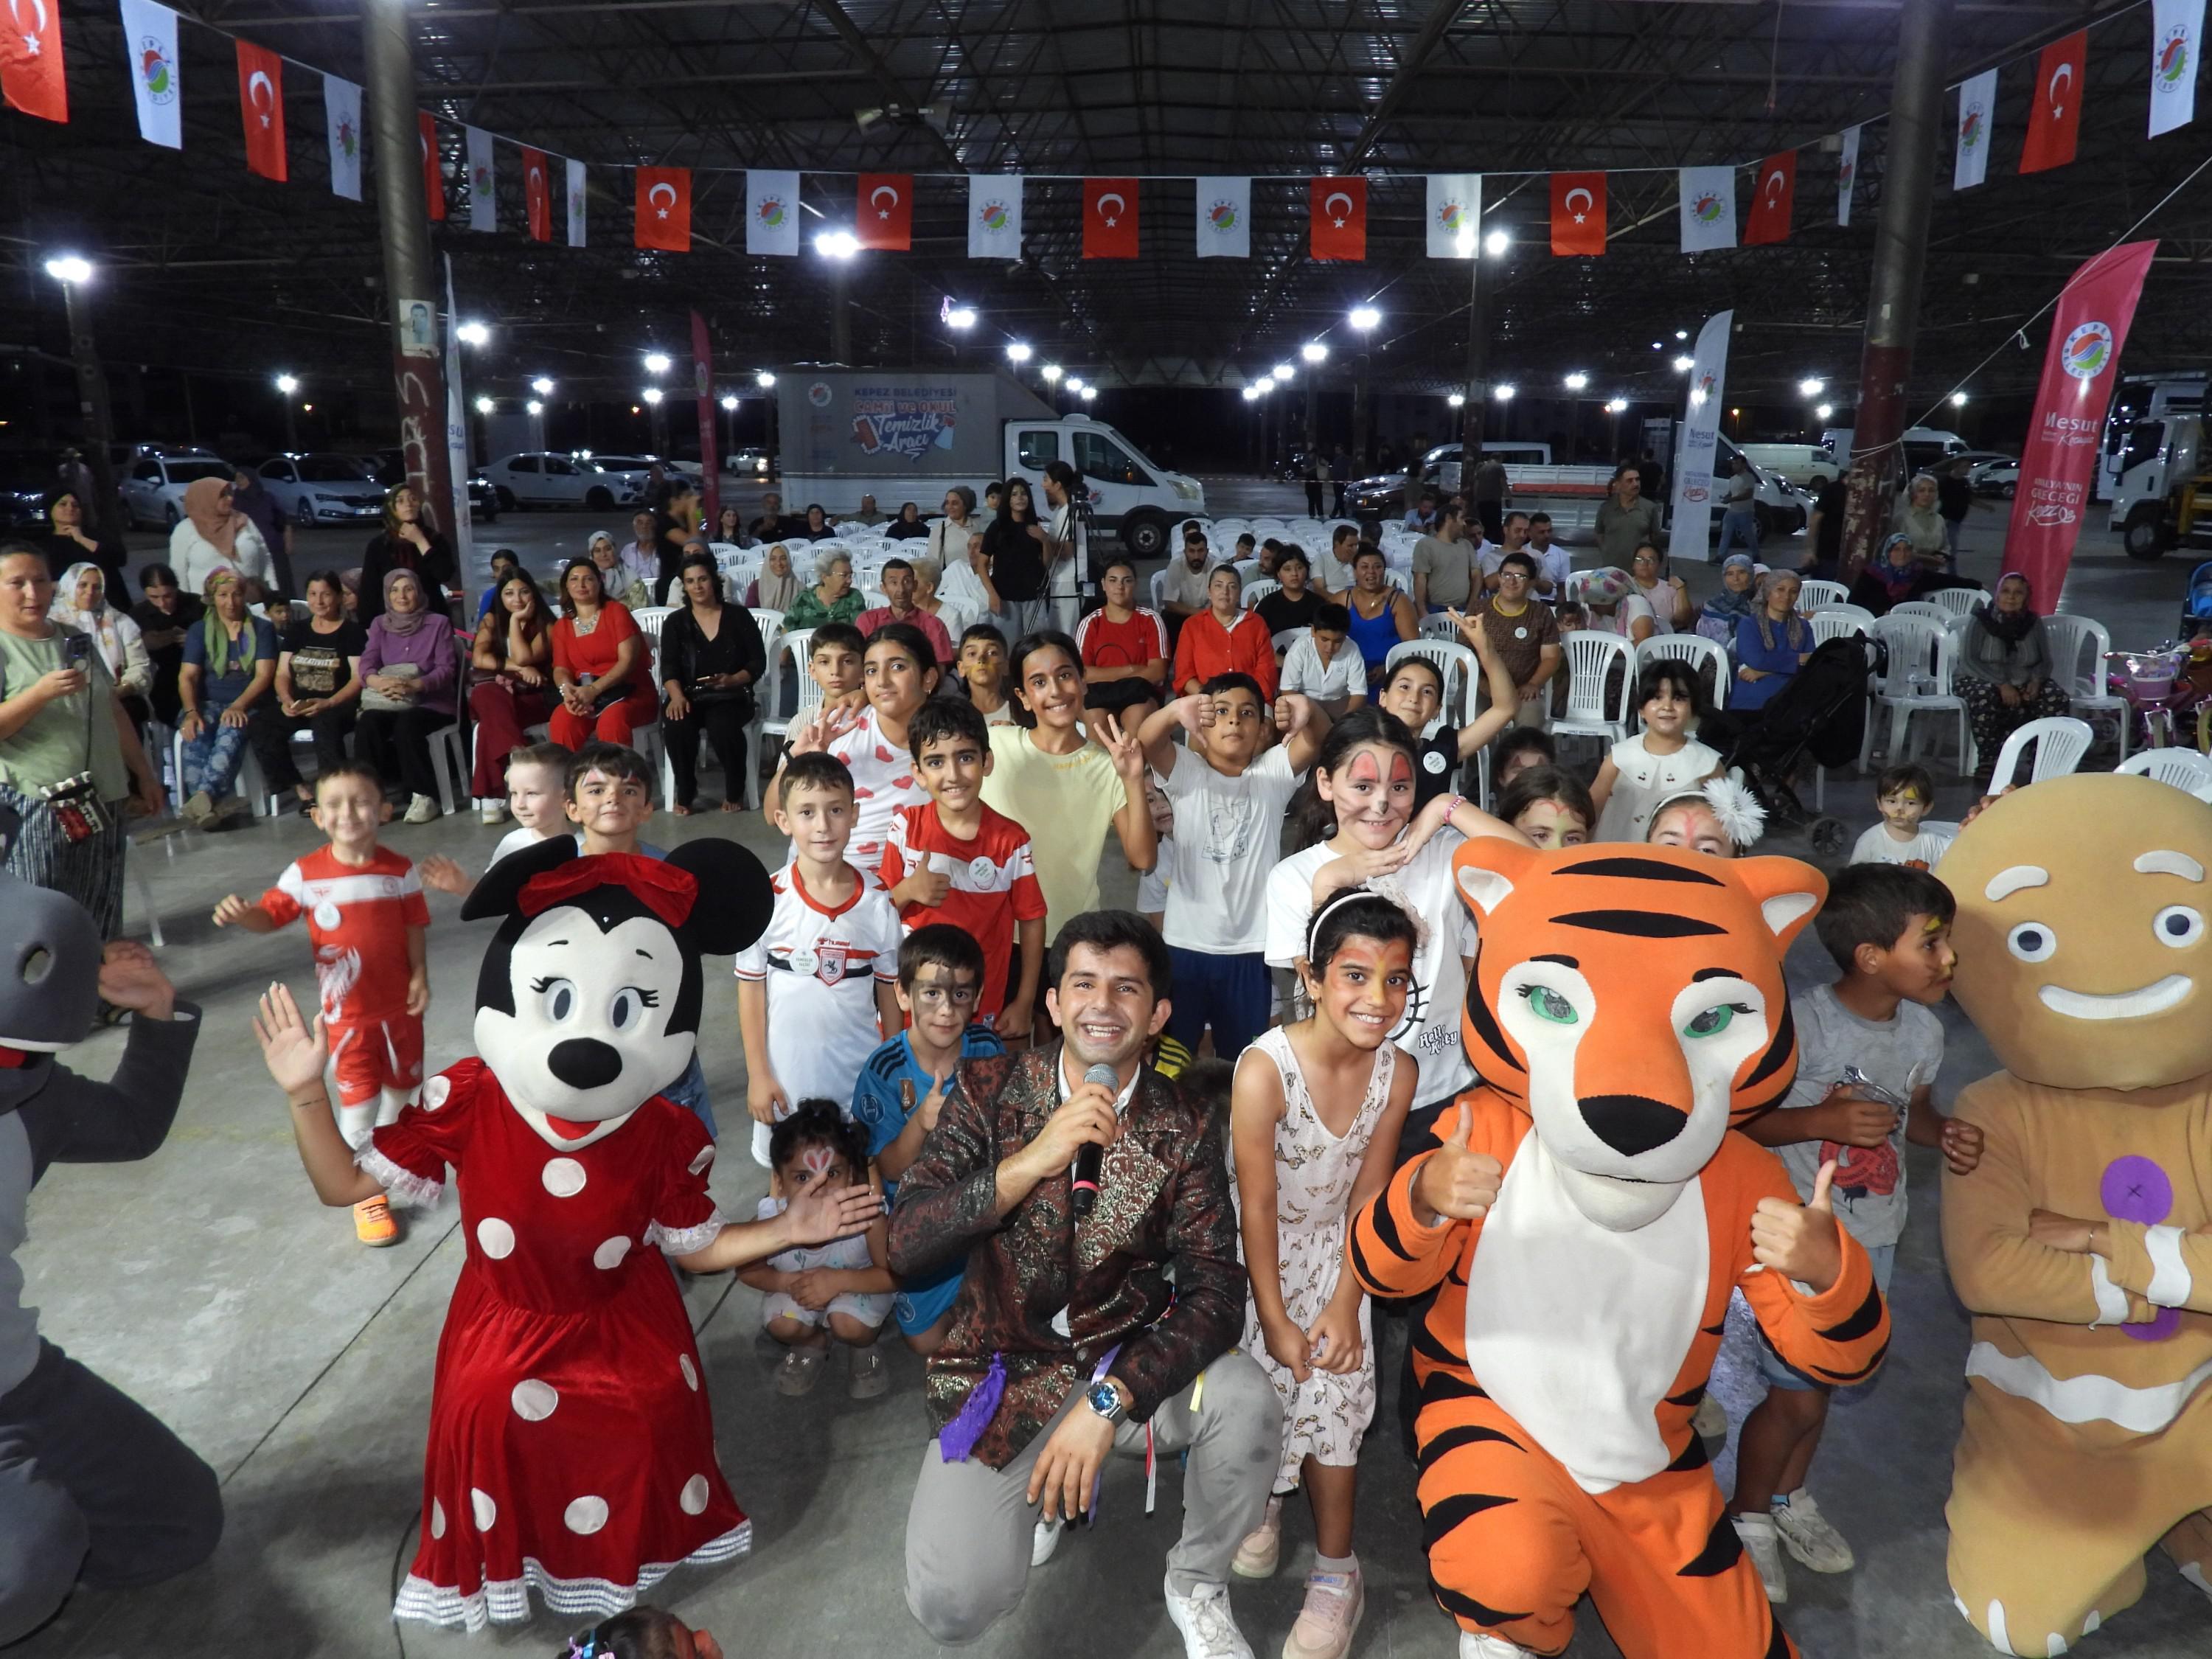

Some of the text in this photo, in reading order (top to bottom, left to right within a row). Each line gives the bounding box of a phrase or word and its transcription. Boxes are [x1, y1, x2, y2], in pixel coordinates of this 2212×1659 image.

[855, 388, 890, 397] KEPEZ
[874, 411, 940, 435] Temizlik
[294, 655, 334, 667] CREATIVITY
